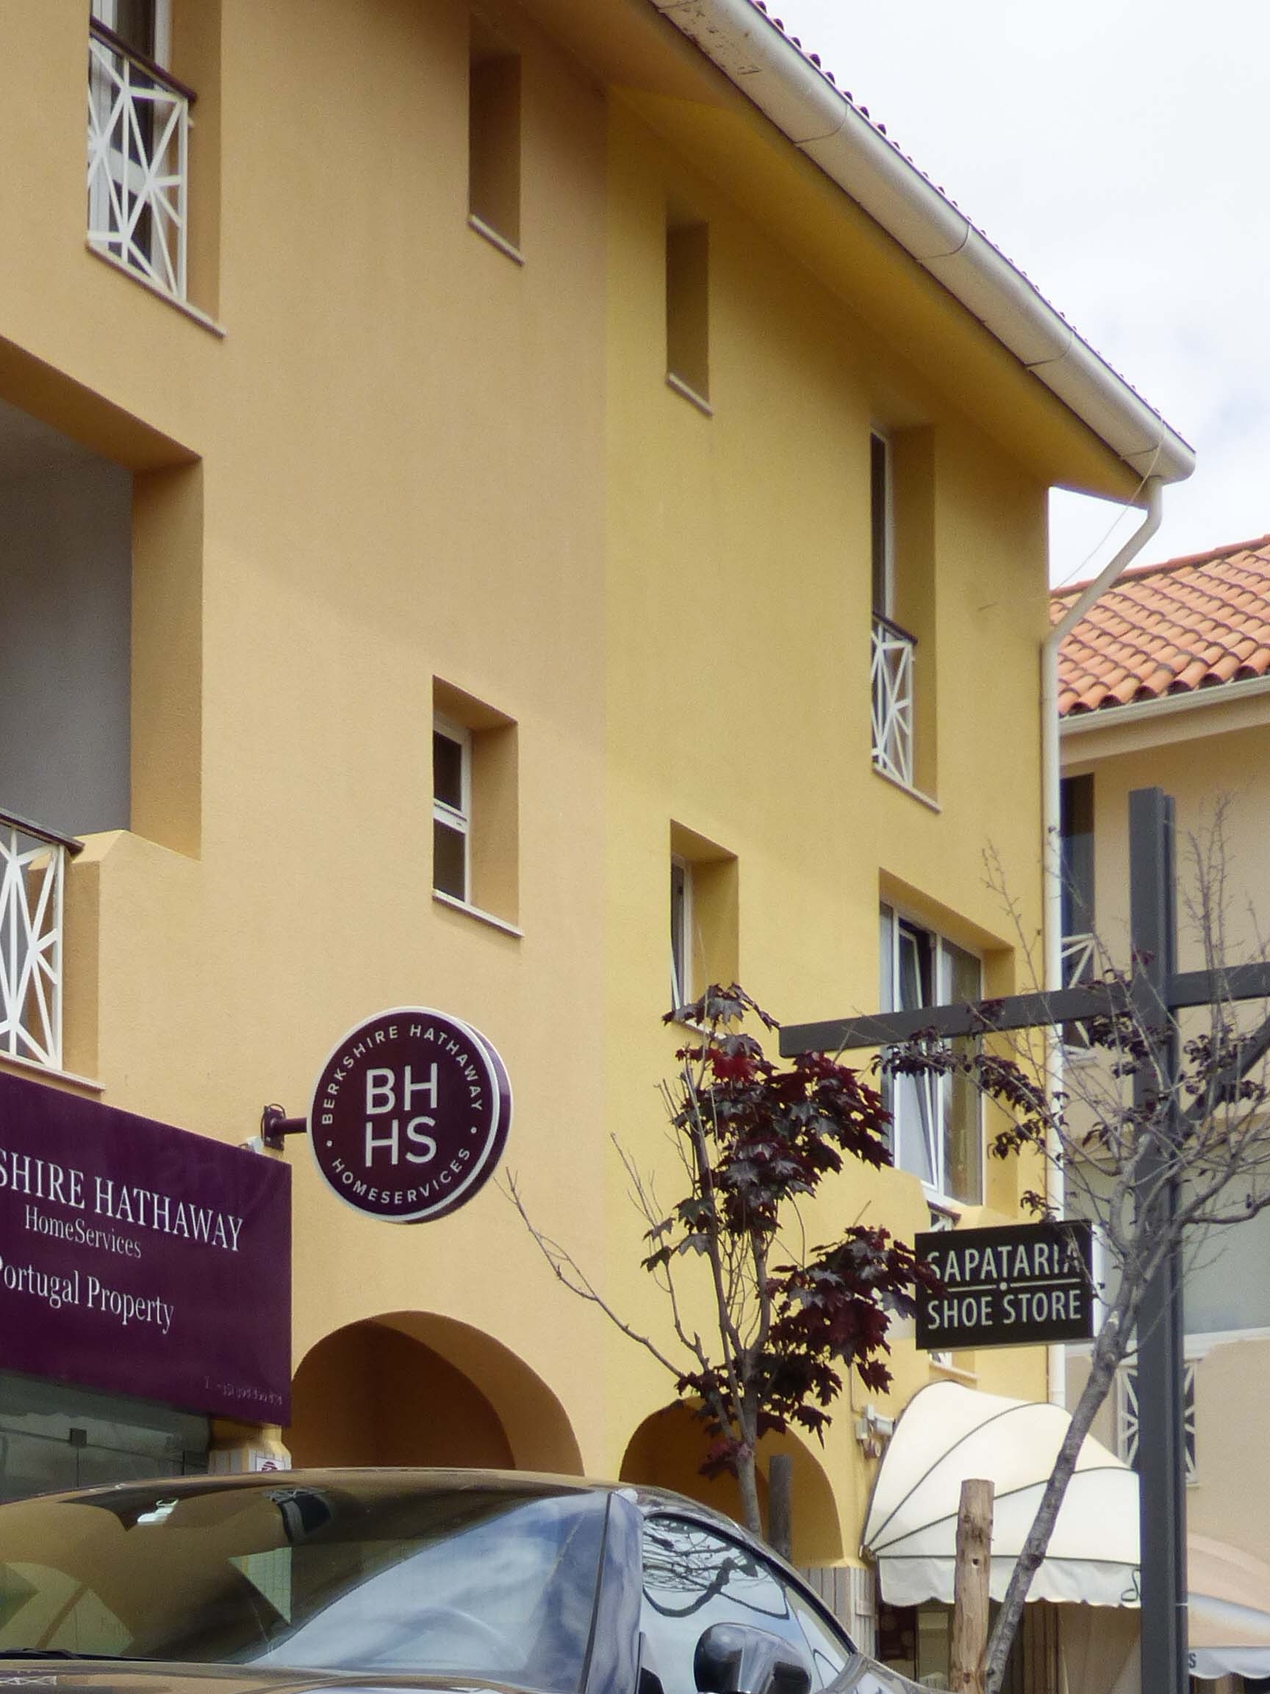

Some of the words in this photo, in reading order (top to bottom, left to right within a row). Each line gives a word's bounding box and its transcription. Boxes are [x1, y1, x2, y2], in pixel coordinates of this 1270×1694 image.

[322, 1025, 398, 1125] BERKSHIRE
[410, 1024, 483, 1111] HATHAWAY
[366, 1062, 438, 1115] BH
[365, 1116, 437, 1167] HS
[332, 1148, 470, 1204] HOMESERVICES
[25, 1204, 142, 1259] HomeServices
[94, 1176, 243, 1252] HATHAWAY
[927, 1243, 1080, 1282] SAPATARIA
[87, 1275, 175, 1335] Property
[927, 1296, 993, 1330] SHOE
[1003, 1289, 1082, 1324] STORE
